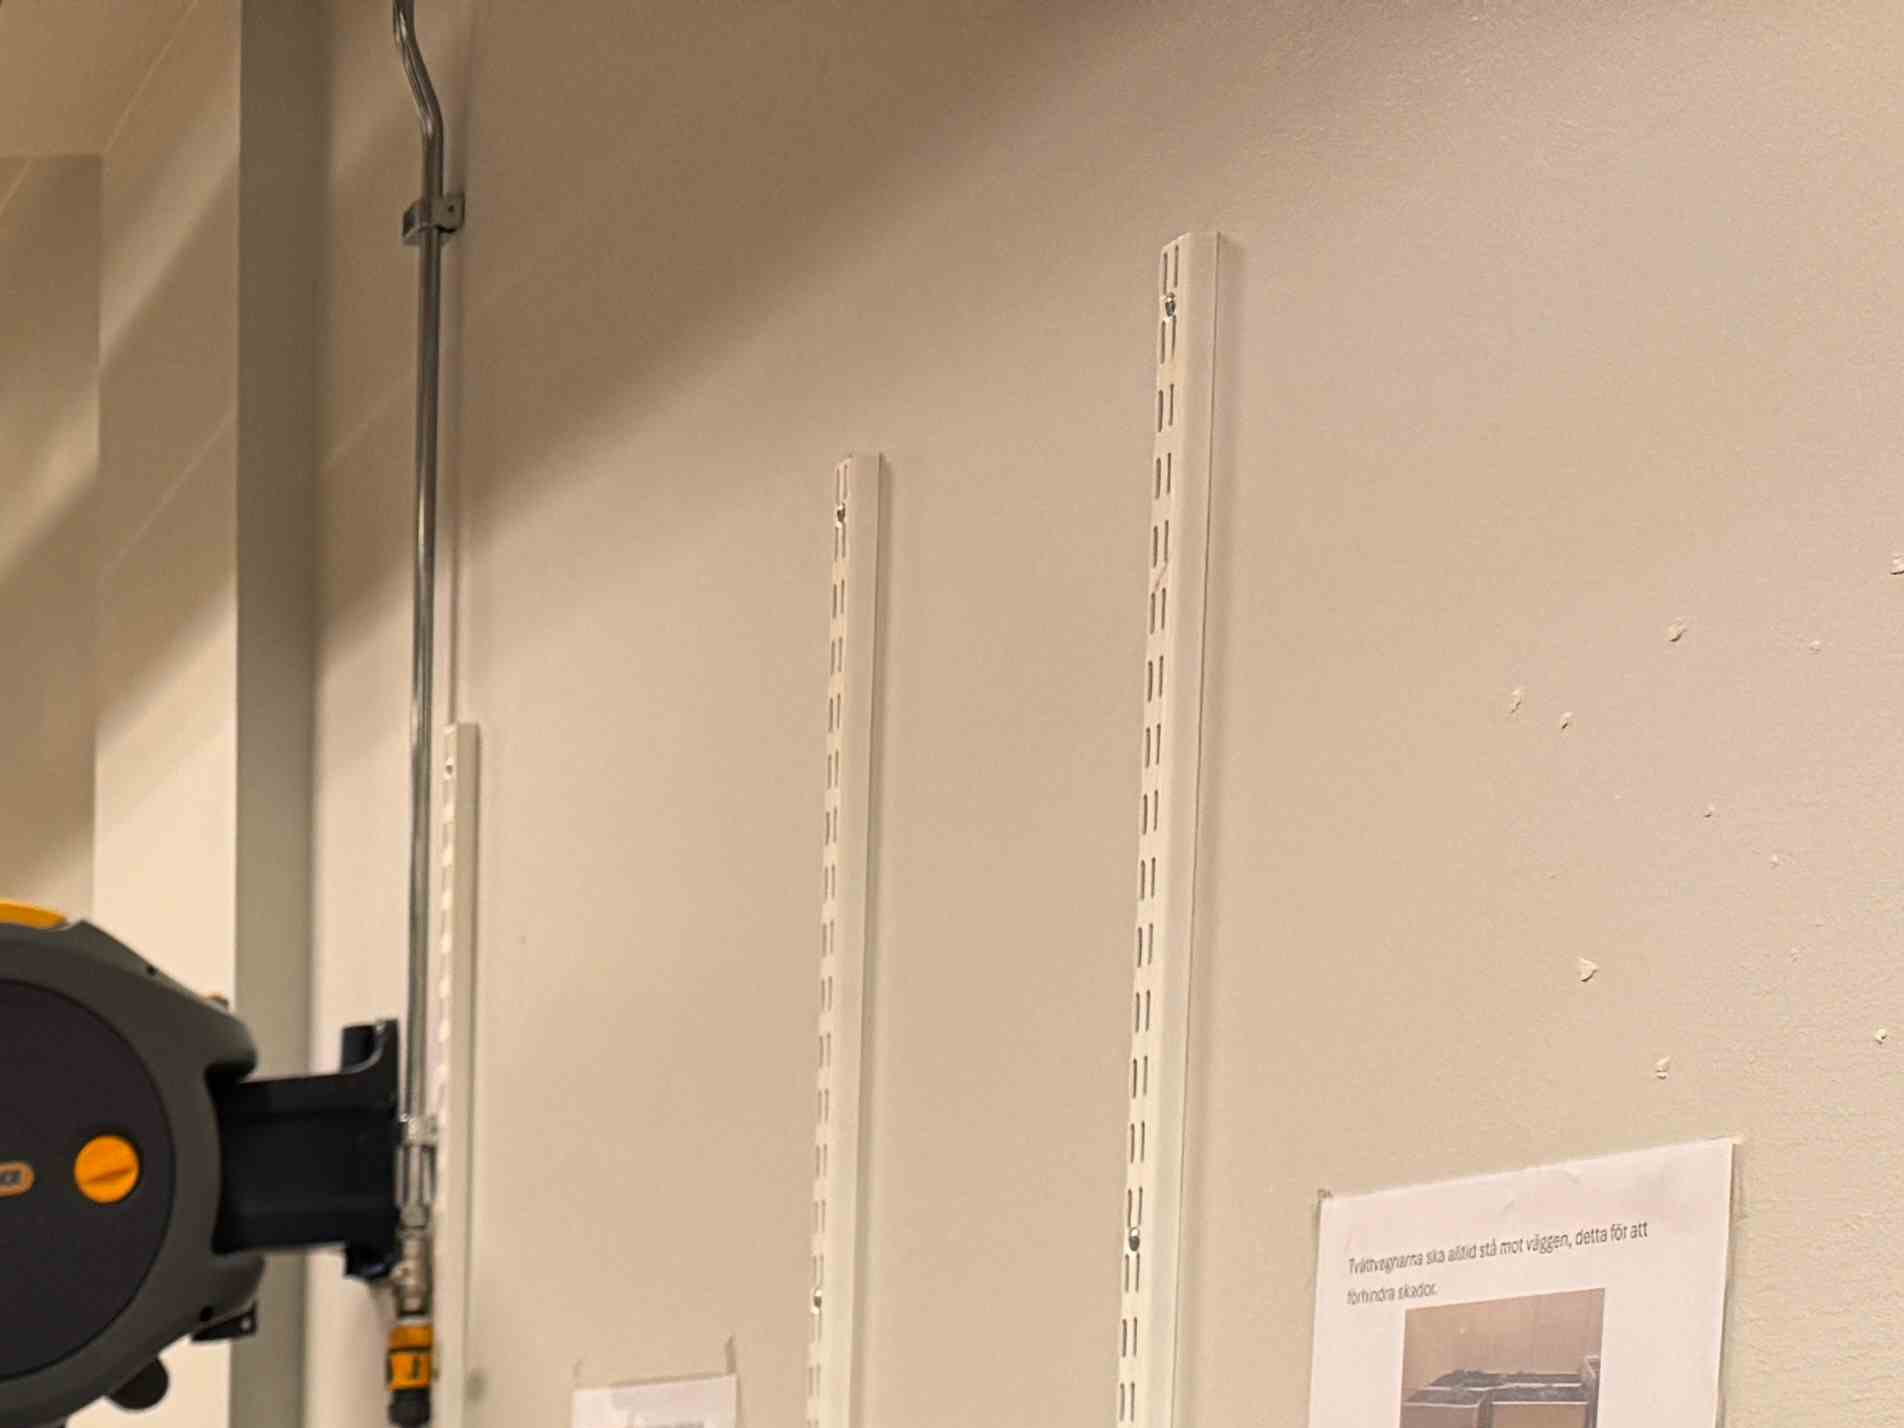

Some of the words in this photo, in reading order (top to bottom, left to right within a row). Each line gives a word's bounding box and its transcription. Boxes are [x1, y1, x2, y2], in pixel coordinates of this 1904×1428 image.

[1500, 1238, 1523, 1255] mot
[1575, 1228, 1608, 1246] detta
[1610, 1223, 1628, 1241] för
[1631, 1221, 1648, 1239] att
